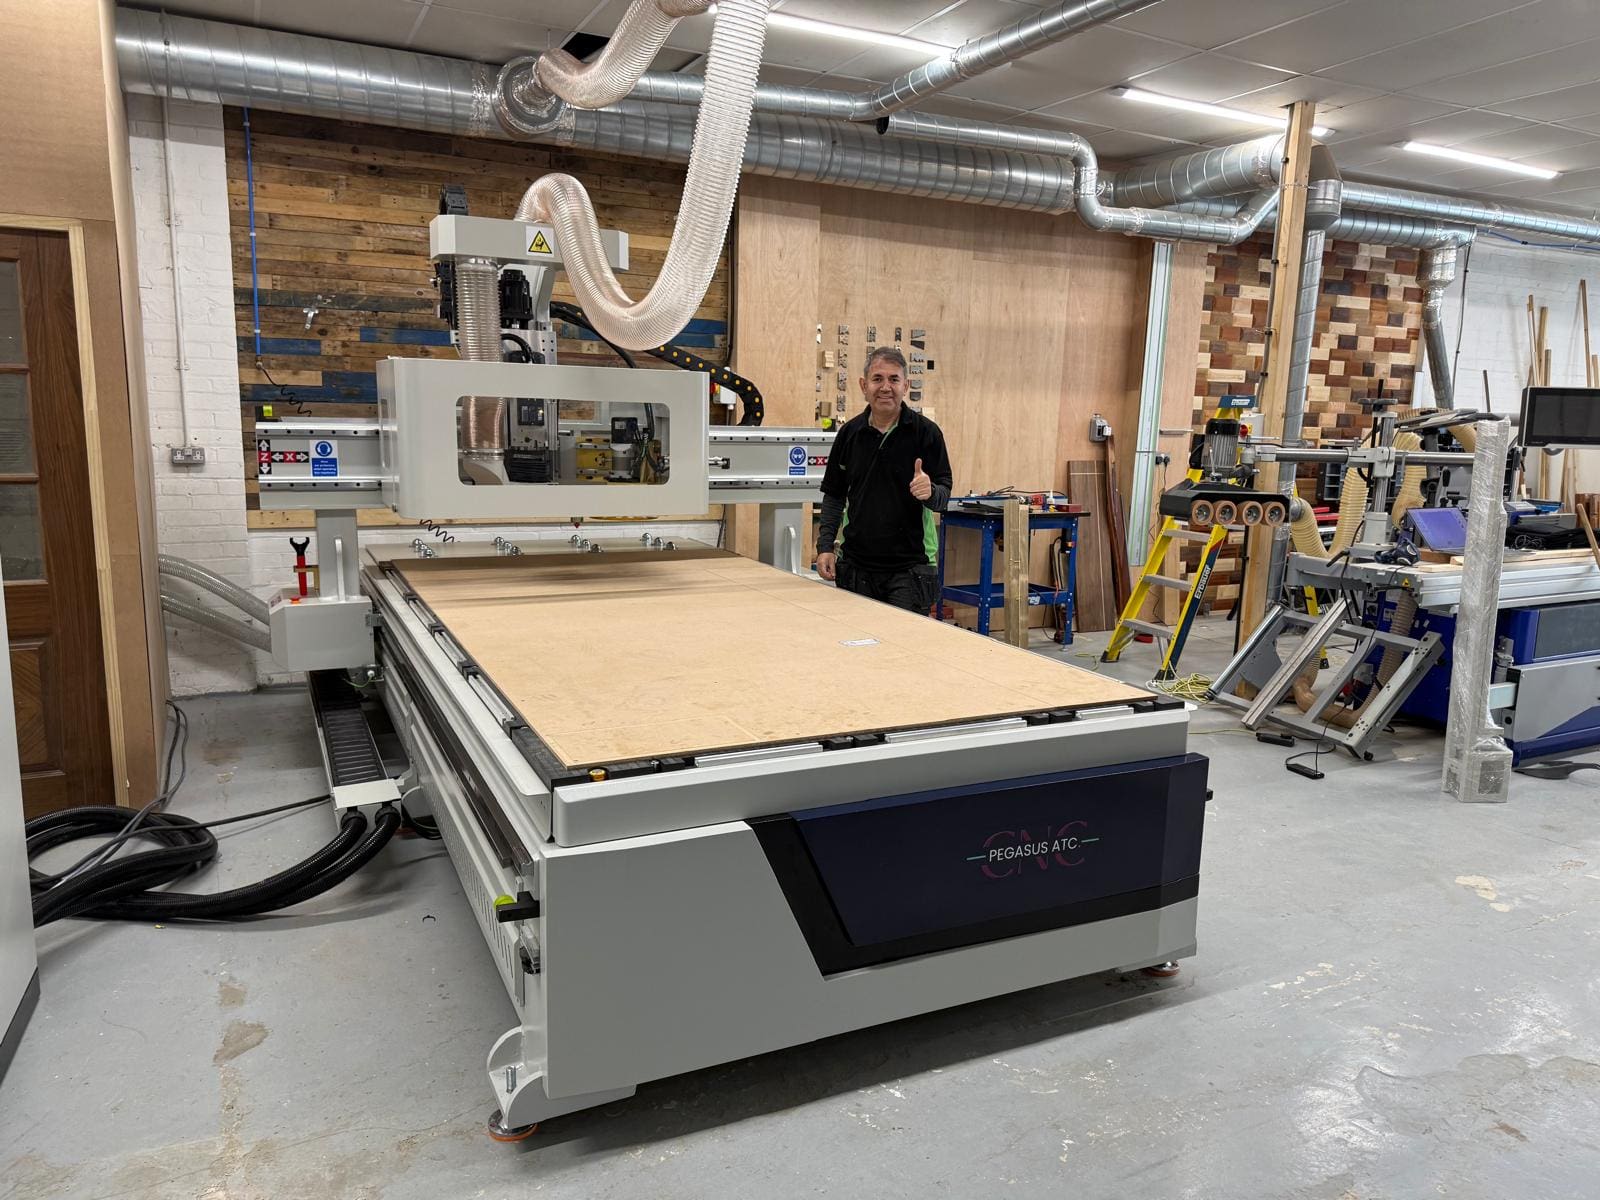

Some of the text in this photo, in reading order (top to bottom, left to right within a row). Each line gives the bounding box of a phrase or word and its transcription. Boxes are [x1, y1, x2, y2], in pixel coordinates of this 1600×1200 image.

[261, 453, 269, 461] Z
[286, 453, 294, 461] X
[817, 457, 824, 465] X
[981, 820, 1088, 879] CNC
[989, 842, 1049, 862] PEGASUS
